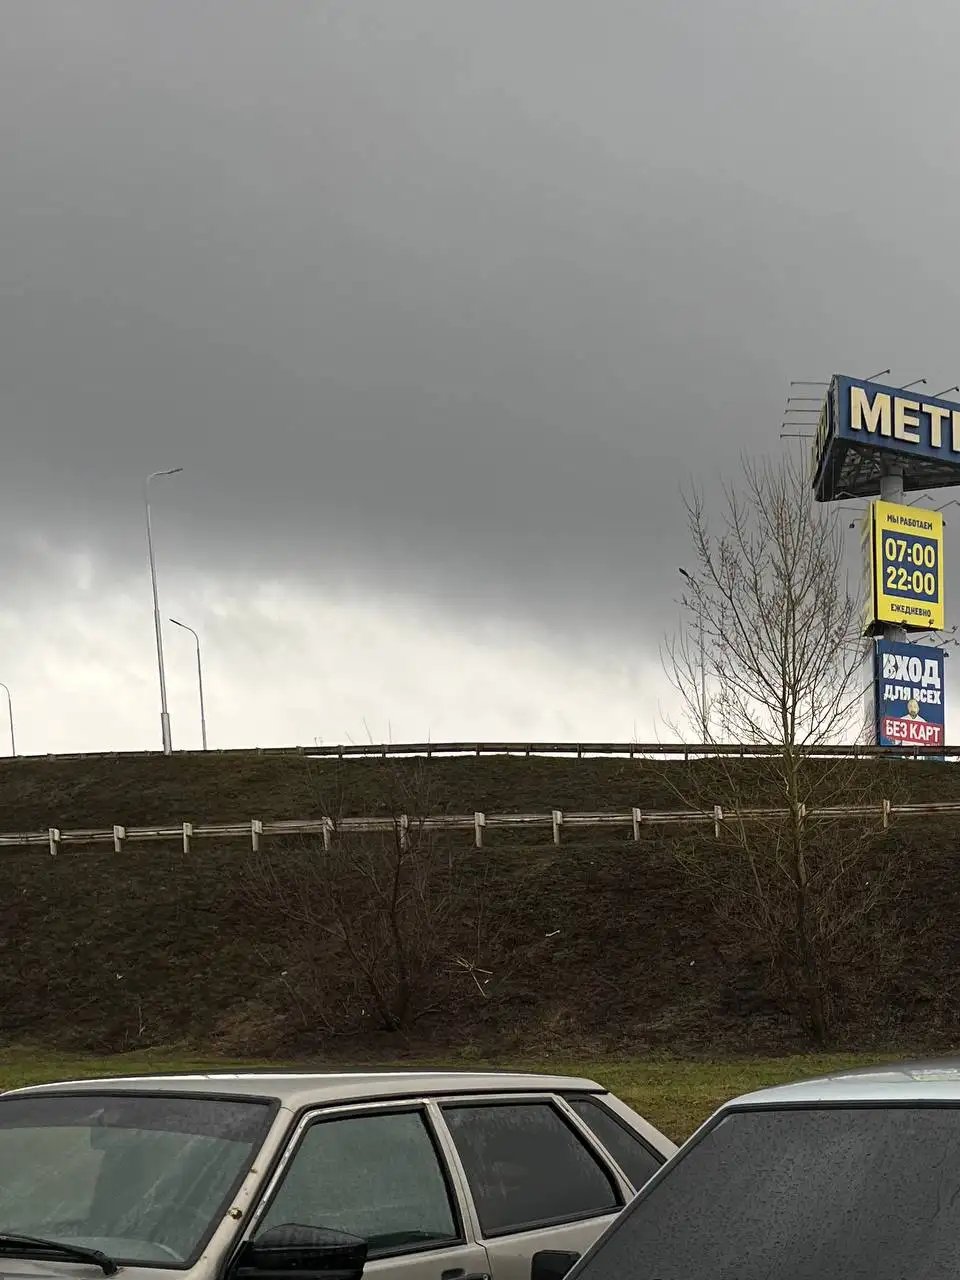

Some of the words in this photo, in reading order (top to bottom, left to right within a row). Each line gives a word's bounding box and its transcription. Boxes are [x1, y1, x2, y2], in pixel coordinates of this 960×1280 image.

[886, 514, 899, 524] МЫ
[899, 518, 933, 531] РАБОТАЕМ
[885, 537, 936, 568] 07:00
[886, 565, 936, 596] 22:00
[890, 603, 932, 618] ЕЖЕДНЕВНО
[882, 653, 941, 689] ВХОД
[883, 684, 911, 701] ДЛЯ
[912, 687, 942, 705] ВСЕХ
[885, 719, 907, 738] БЕЗ
[909, 723, 941, 743] КАРТ
